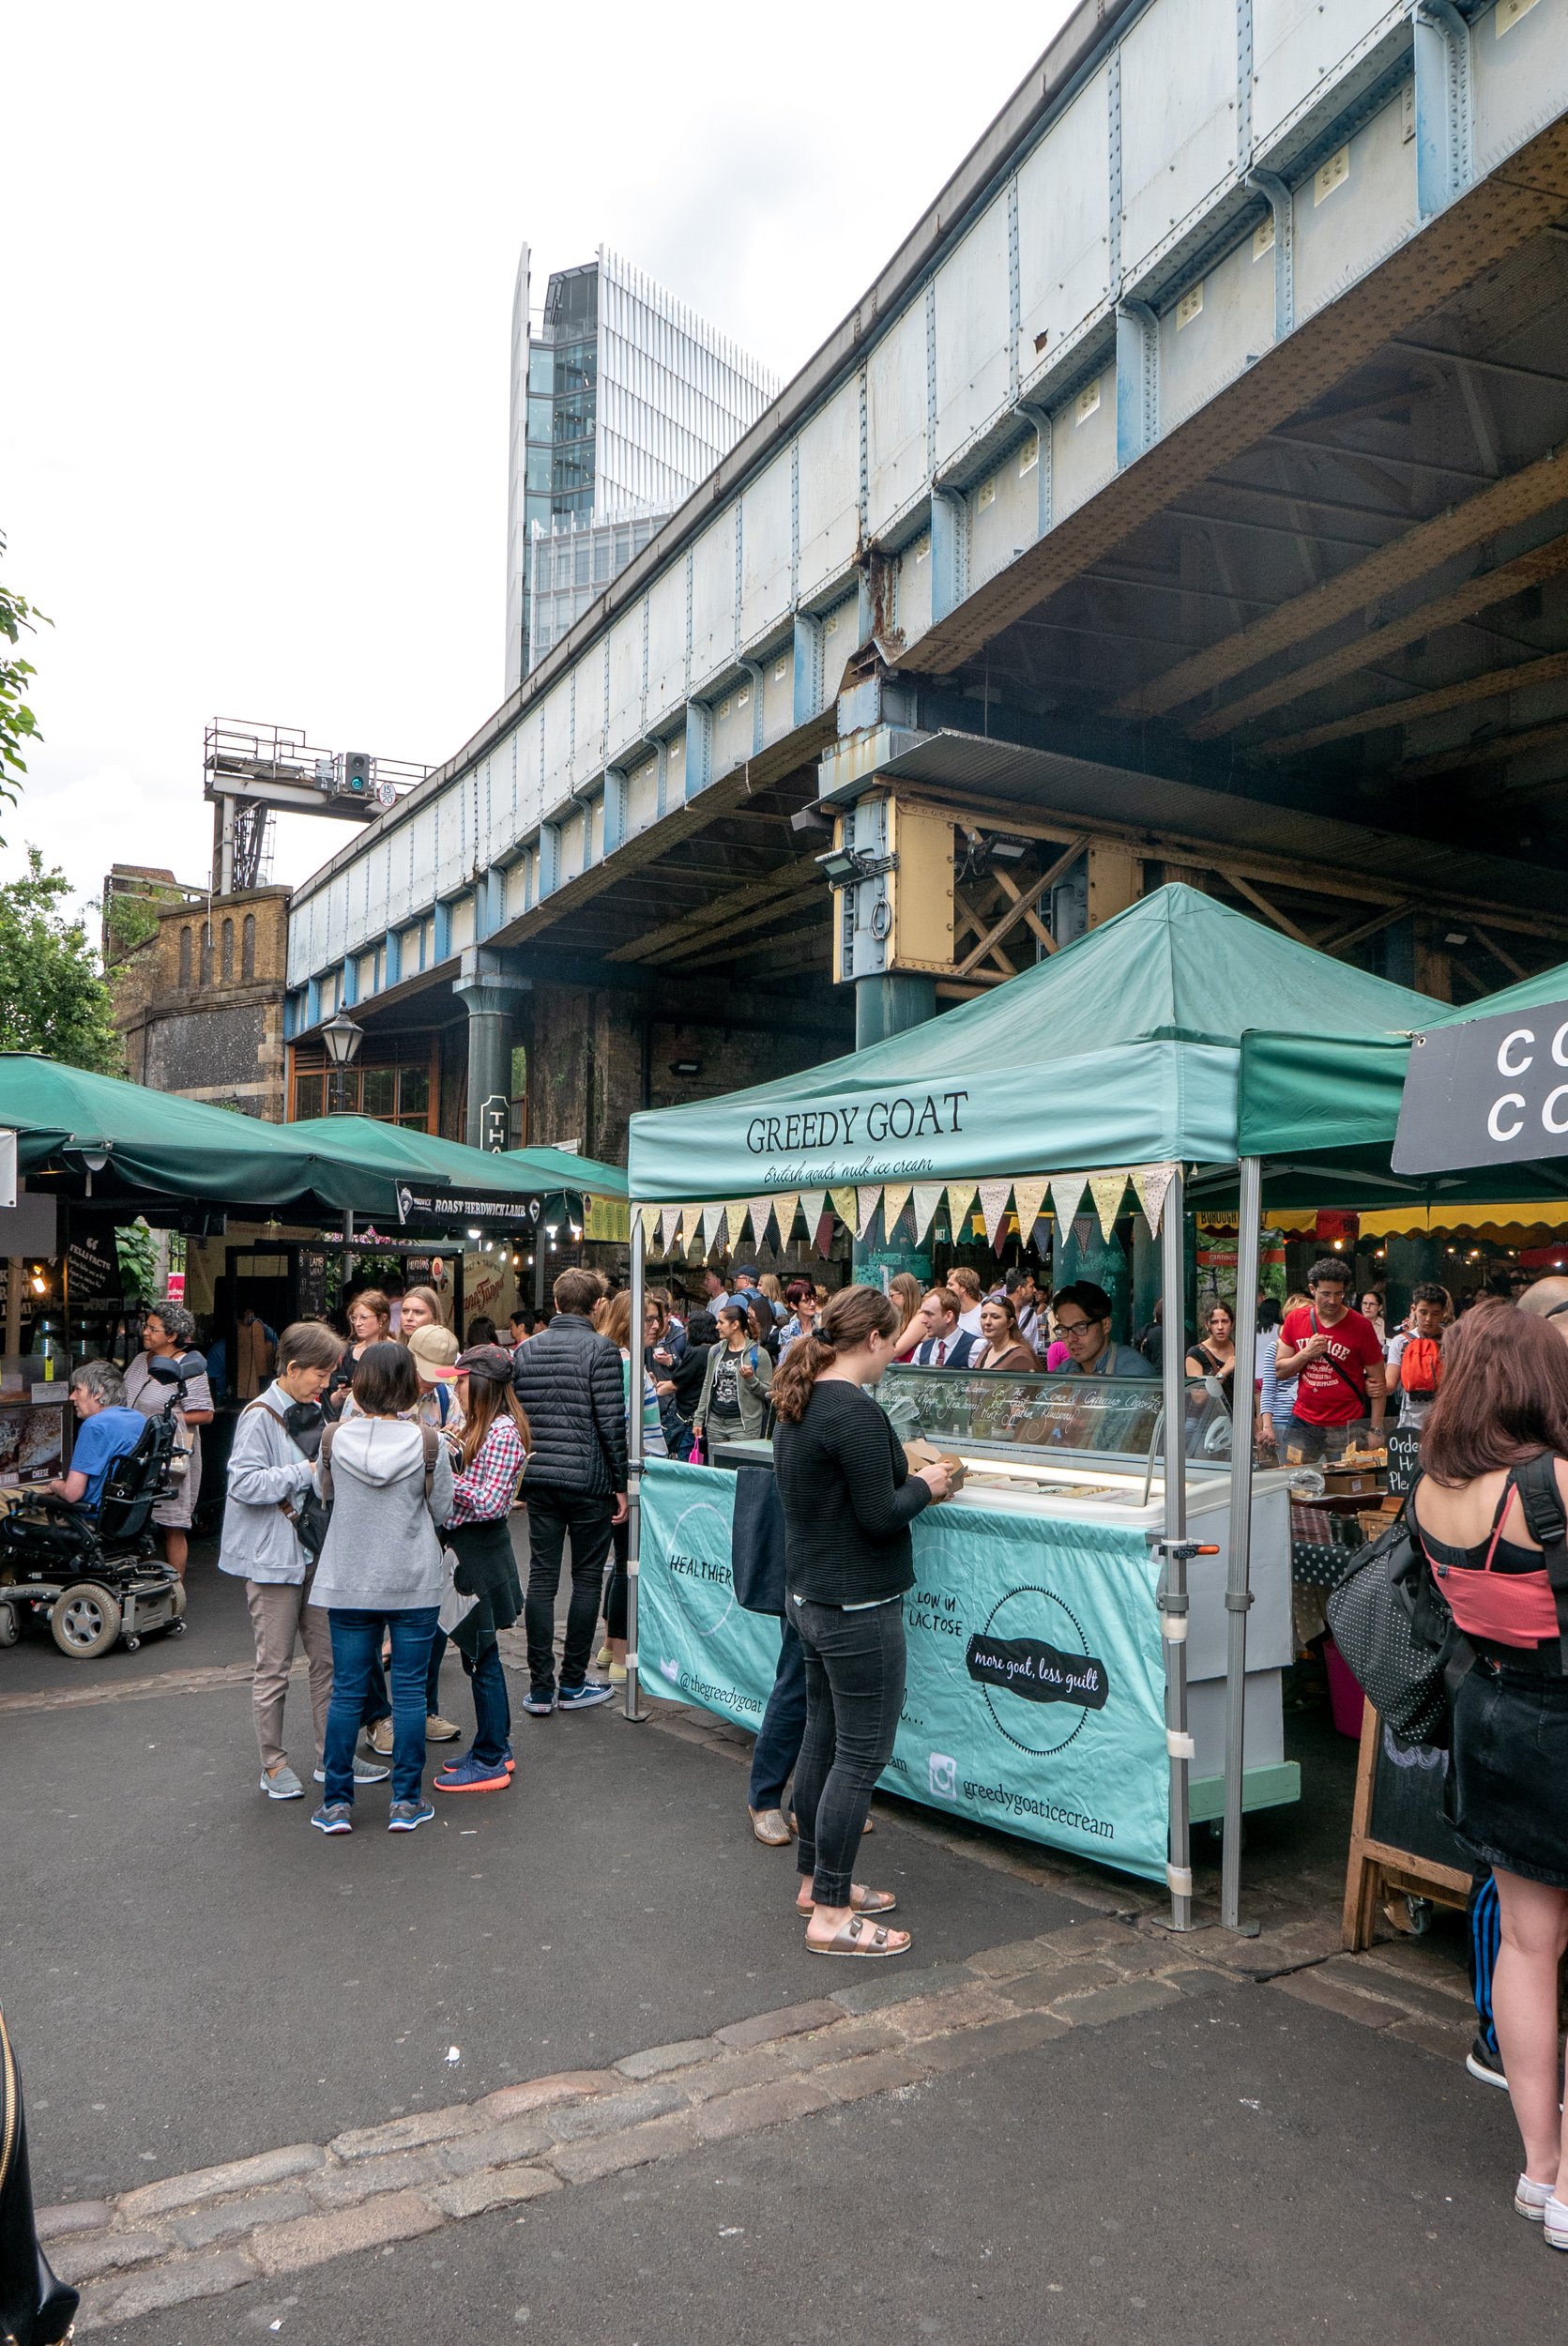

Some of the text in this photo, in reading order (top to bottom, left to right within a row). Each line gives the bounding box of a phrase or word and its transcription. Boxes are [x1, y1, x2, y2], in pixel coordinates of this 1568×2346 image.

[382, 795, 393, 804] 20
[746, 1090, 968, 1154] GREEDY GOAT
[843, 1155, 874, 1177] milk
[874, 1162, 891, 1174] ice
[893, 1157, 933, 1172] cream
[434, 1199, 463, 1213] ROAST
[464, 1199, 506, 1217] HERDWICK
[505, 1204, 526, 1217] LAMB
[1296, 1338, 1350, 1362] VAGE
[1389, 1471, 1409, 1490] Ple
[917, 1591, 941, 1607] LOW
[909, 1609, 963, 1637] LACTOSE
[974, 1651, 1099, 1693] more goat, less guilt
[680, 1672, 763, 1714] @thegreedygoat
[963, 1780, 1115, 1839] greedygoaticecream
